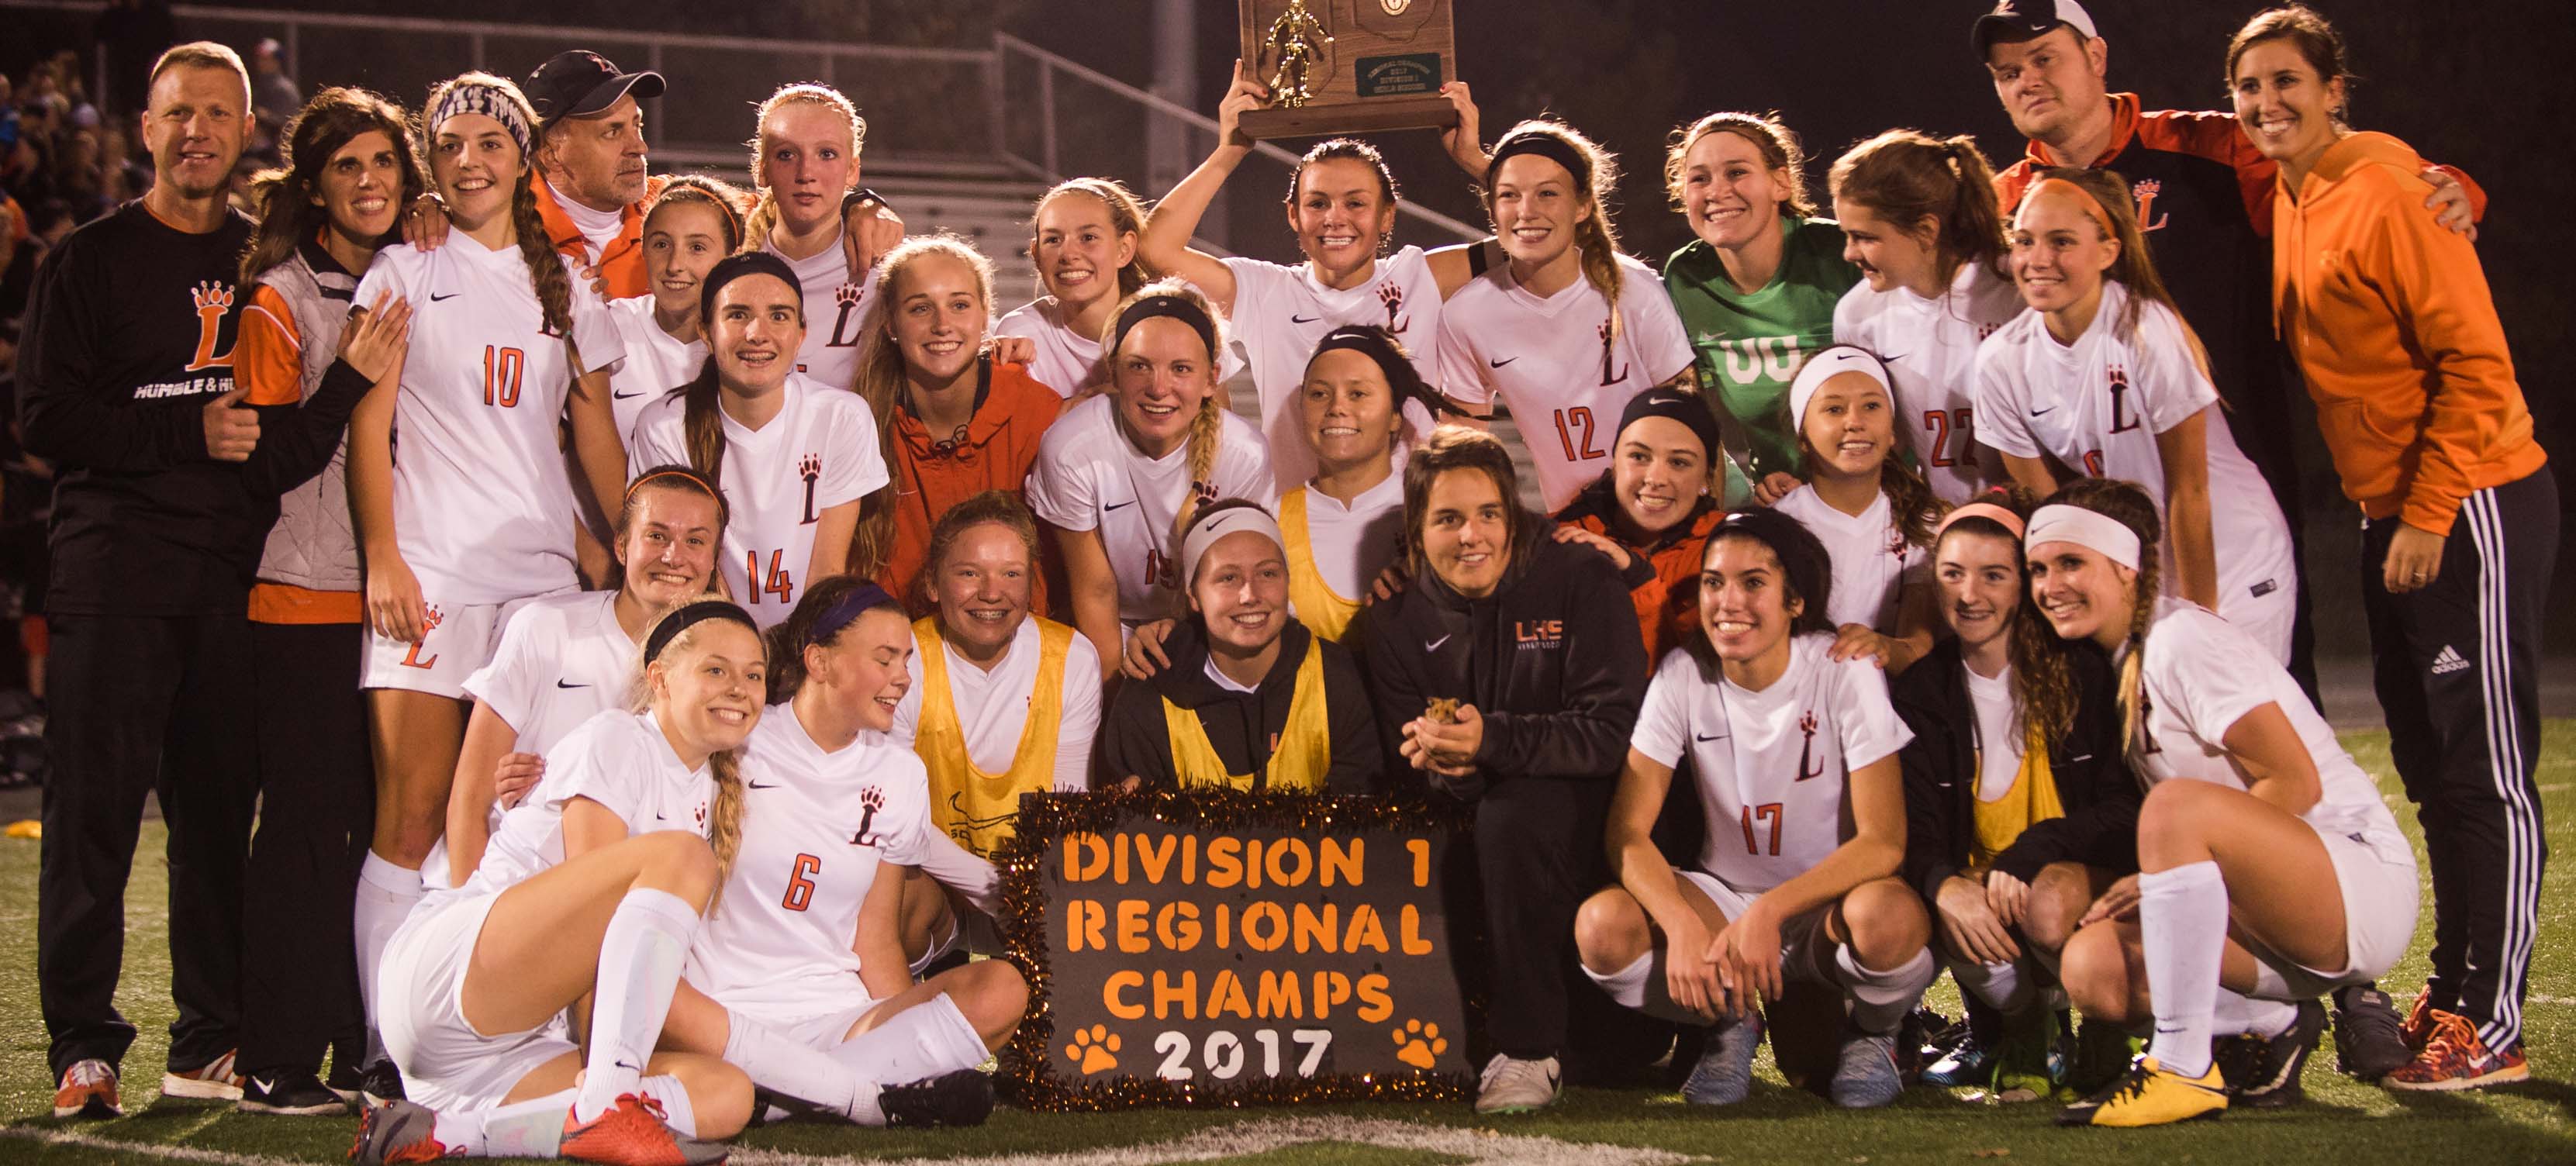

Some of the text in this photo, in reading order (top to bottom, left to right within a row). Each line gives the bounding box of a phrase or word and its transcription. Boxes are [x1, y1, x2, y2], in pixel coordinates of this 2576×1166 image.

[185, 303, 237, 372] L
[825, 300, 863, 347] L
[484, 345, 524, 408] 10
[1600, 336, 1628, 387] L
[133, 379, 205, 399] HUMBLE
[205, 378, 216, 392] &
[2109, 383, 2141, 434] L
[1554, 406, 1606, 461] 12
[1924, 409, 1980, 467] 22
[748, 549, 792, 604] 14
[400, 620, 437, 670] L
[1516, 620, 1563, 642] LHS
[2432, 659, 2470, 674] adidas
[1794, 730, 1825, 782] L
[849, 803, 881, 847] L
[1741, 802, 1783, 857] 17
[782, 853, 822, 912] 6
[1063, 833, 1431, 889] DIVISION 1
[1066, 899, 1433, 955] REGIONAL
[1103, 969, 1395, 1023] CHAMPS
[1154, 1029, 1332, 1081] 2017
